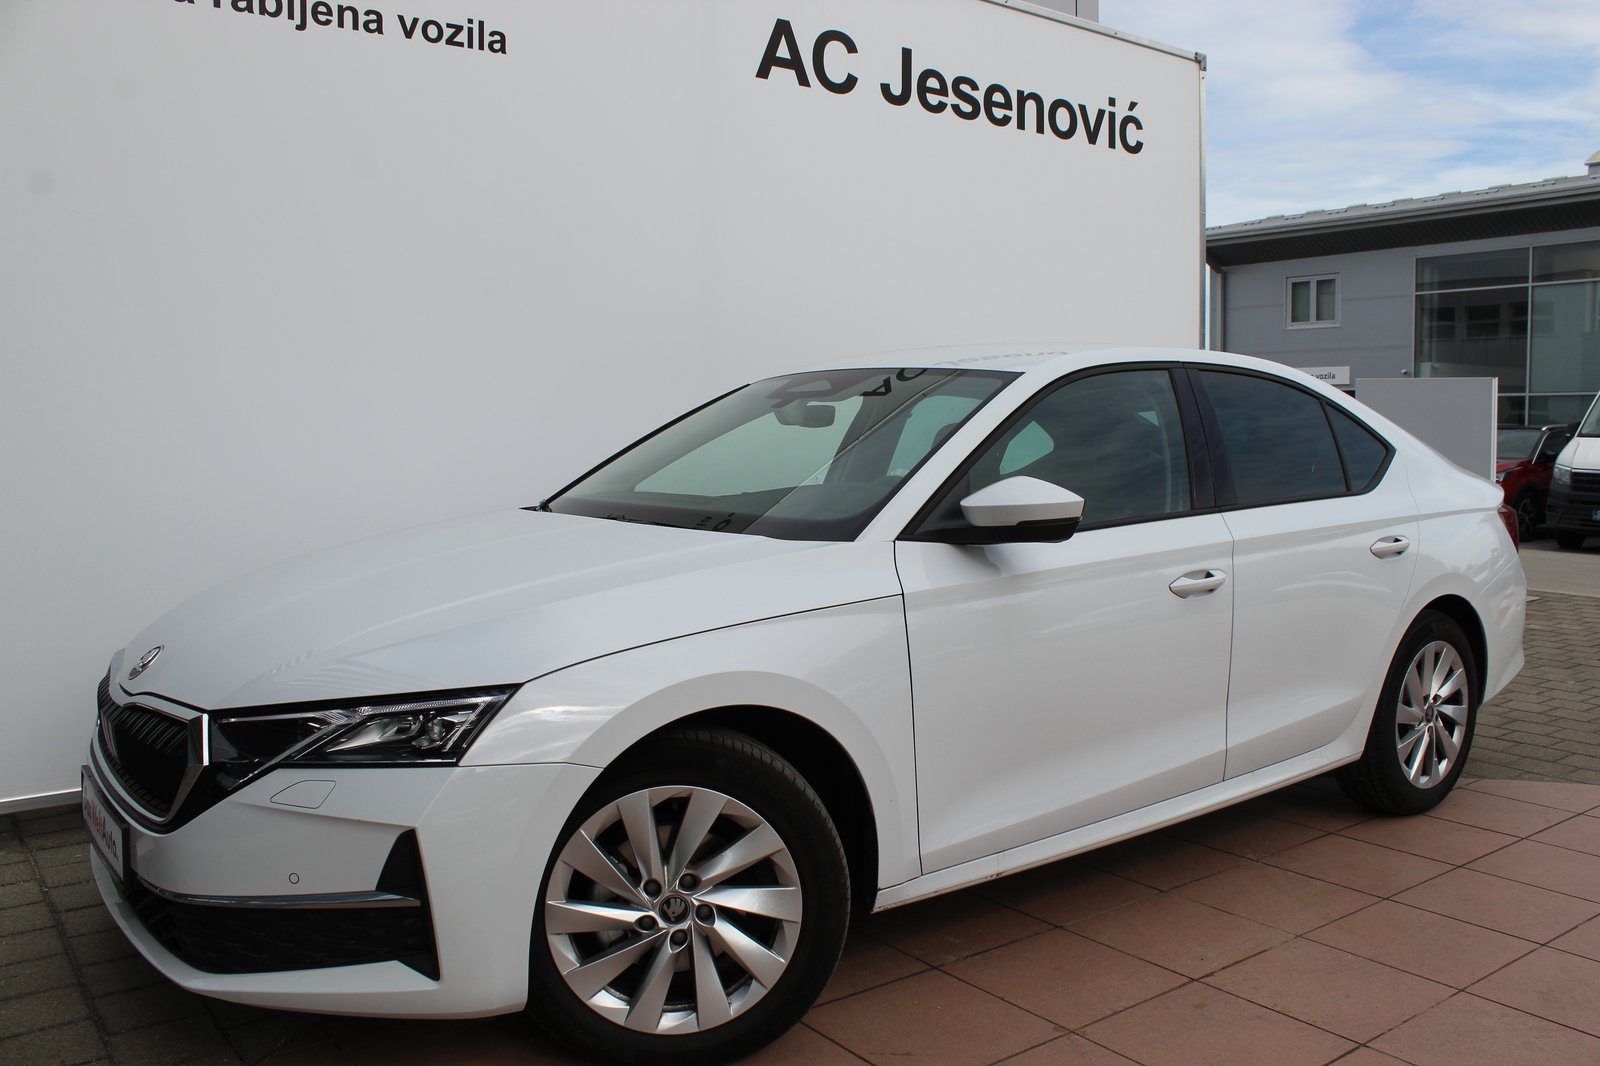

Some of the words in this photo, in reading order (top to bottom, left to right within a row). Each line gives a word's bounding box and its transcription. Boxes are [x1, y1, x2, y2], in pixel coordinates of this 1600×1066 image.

[397, 14, 507, 54] vozila
[755, 18, 859, 95] AC
[879, 46, 1144, 155] Jesenović
